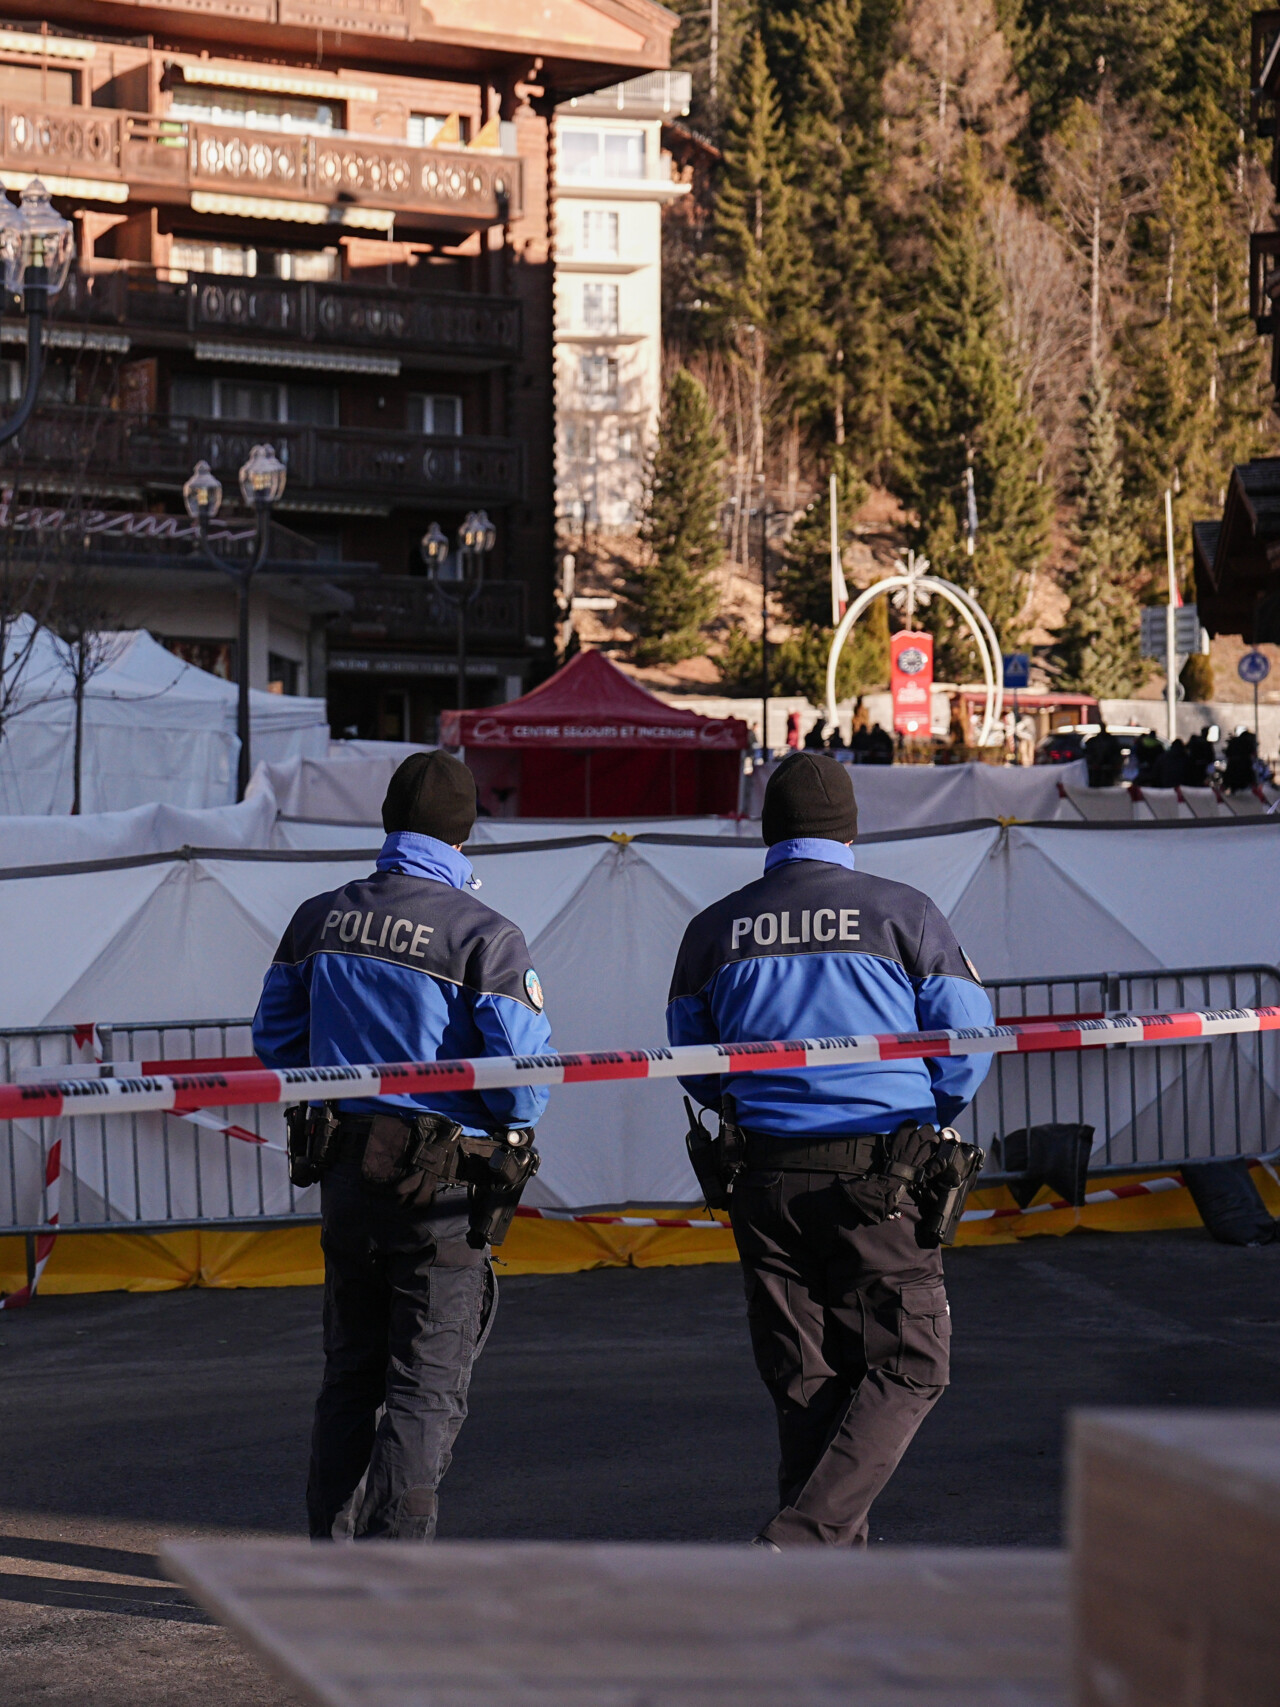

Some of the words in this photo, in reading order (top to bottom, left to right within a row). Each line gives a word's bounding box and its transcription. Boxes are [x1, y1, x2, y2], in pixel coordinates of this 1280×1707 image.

[512, 725, 560, 738] CENTRE
[562, 725, 618, 739] SECOURS
[620, 726, 635, 738] ET
[637, 727, 696, 739] INCENDIE
[320, 909, 435, 959] POLICE
[731, 908, 861, 950] POLICE
